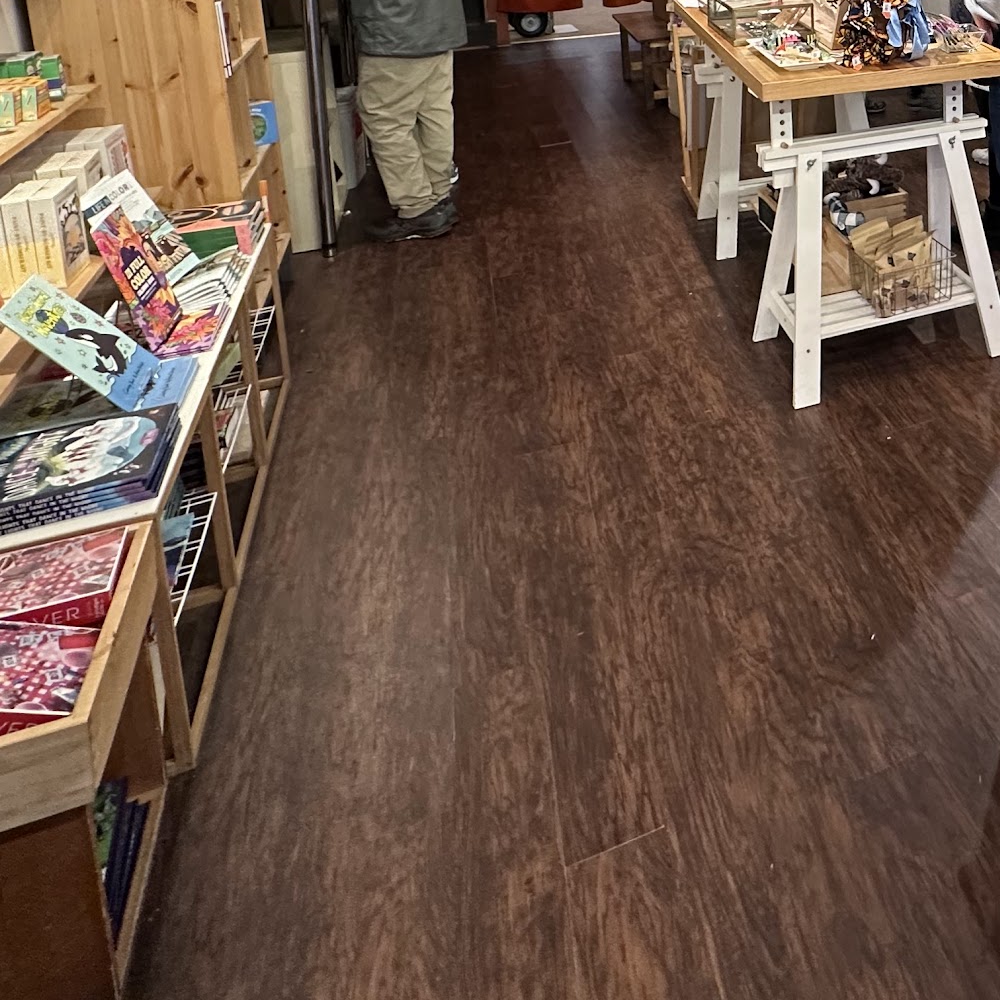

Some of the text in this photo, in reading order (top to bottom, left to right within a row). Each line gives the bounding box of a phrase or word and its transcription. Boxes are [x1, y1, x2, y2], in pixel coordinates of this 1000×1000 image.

[107, 182, 130, 200] COLOR
[127, 255, 145, 272] FULL
[127, 264, 154, 290] COLOR
